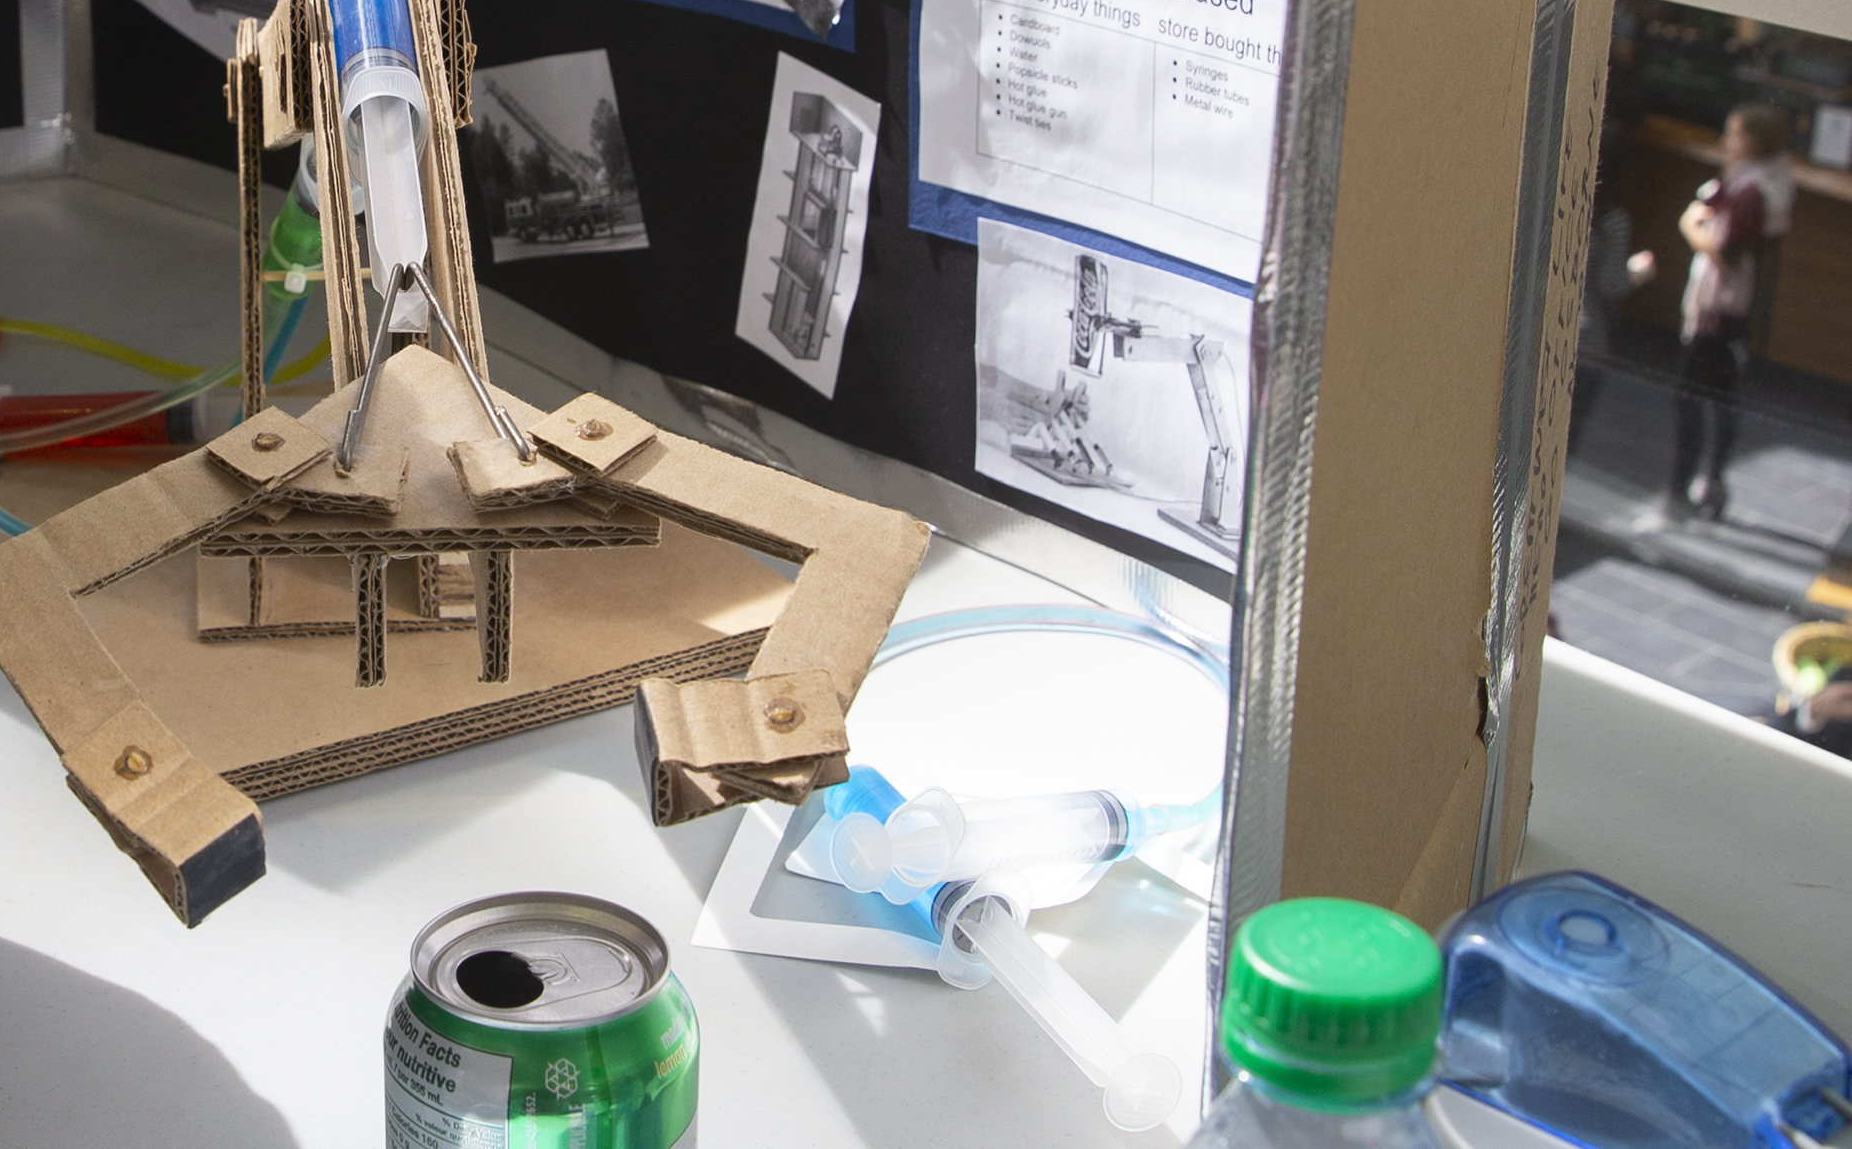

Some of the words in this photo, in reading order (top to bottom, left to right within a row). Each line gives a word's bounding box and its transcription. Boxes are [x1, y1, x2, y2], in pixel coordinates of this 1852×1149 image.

[1094, 0, 1140, 30] things
[1158, 18, 1199, 43] store
[1204, 26, 1261, 60] bought
[1186, 59, 1228, 82] Syringes
[1184, 94, 1212, 112] Metal
[1214, 104, 1234, 118] wire
[1185, 76, 1221, 97] Rubber
[1224, 89, 1249, 106] tubes
[418, 1031, 462, 1068] Facts
[654, 1043, 689, 1079] lemon
[396, 1045, 456, 1093] nutritive
[410, 1078, 426, 1097] 355
[427, 1091, 444, 1106] mL
